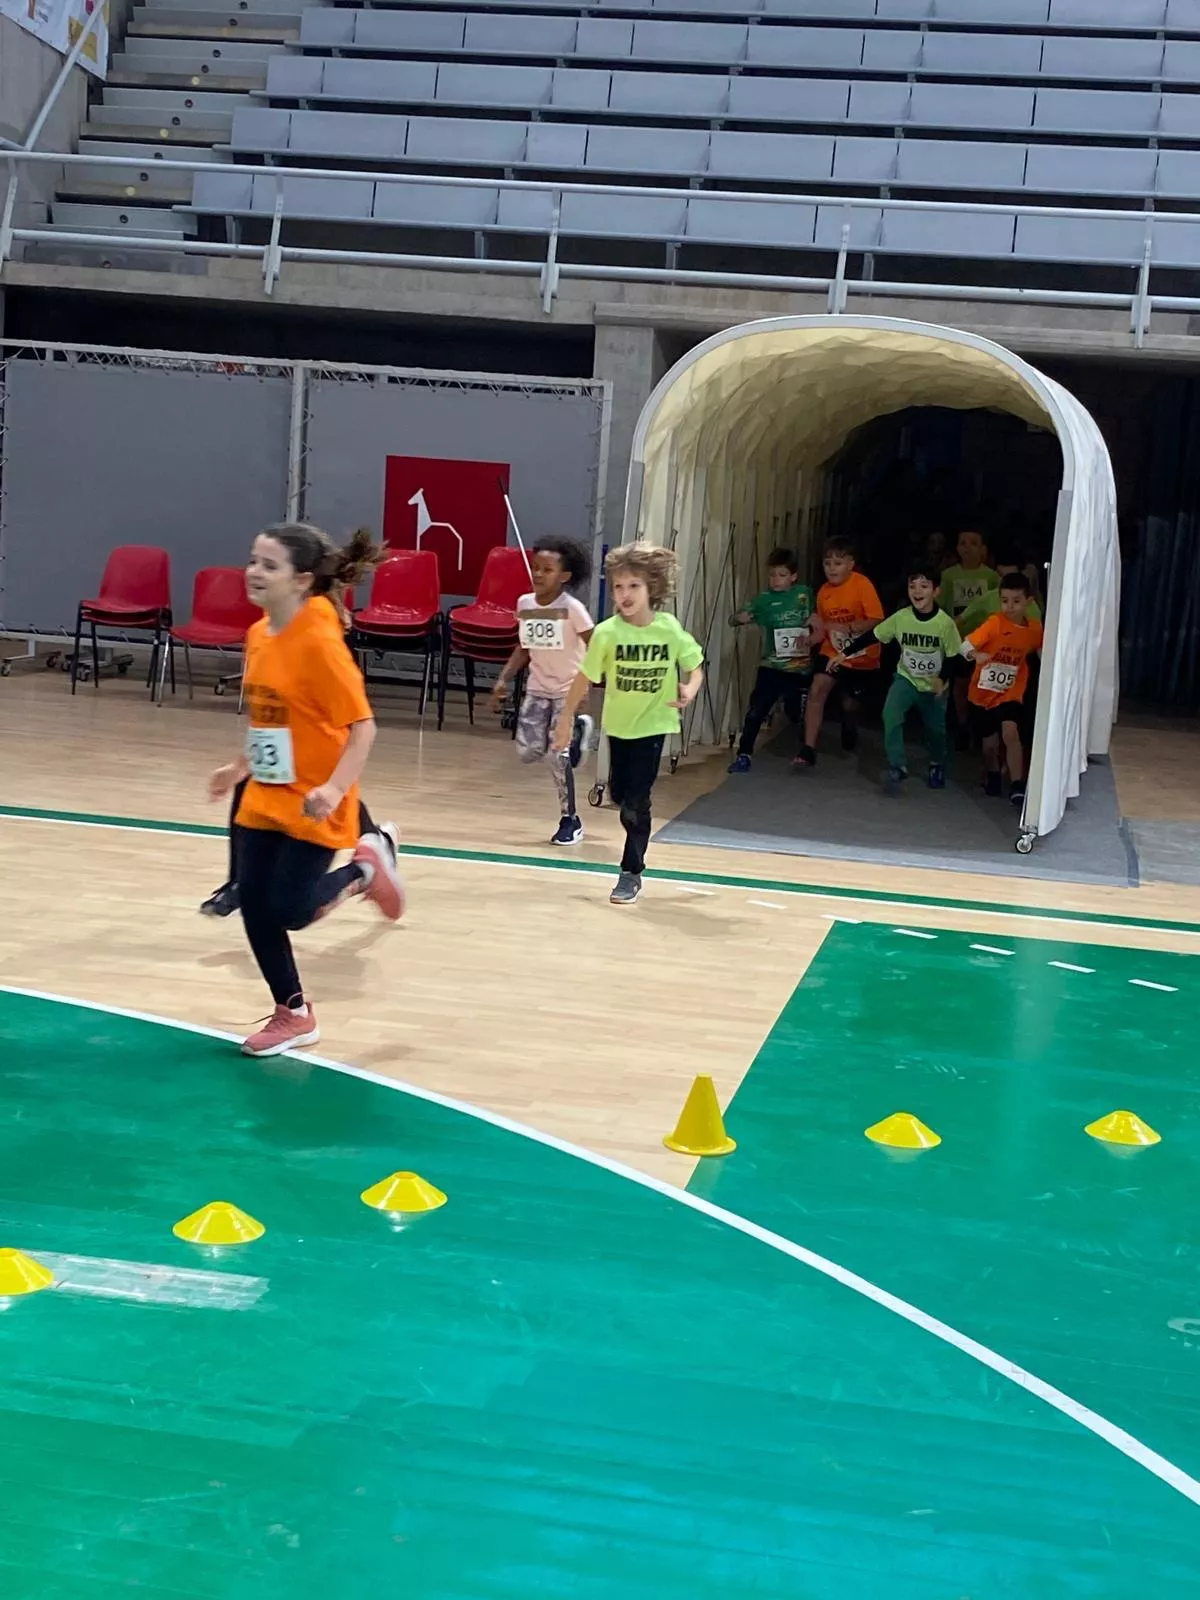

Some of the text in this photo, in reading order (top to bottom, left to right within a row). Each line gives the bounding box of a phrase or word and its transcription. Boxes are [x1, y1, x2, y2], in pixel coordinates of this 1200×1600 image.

[526, 622, 555, 638] 308
[902, 632, 940, 648] AMYPA
[616, 644, 669, 661] AMYPA
[909, 658, 936, 671] 366
[988, 670, 1016, 686] 305
